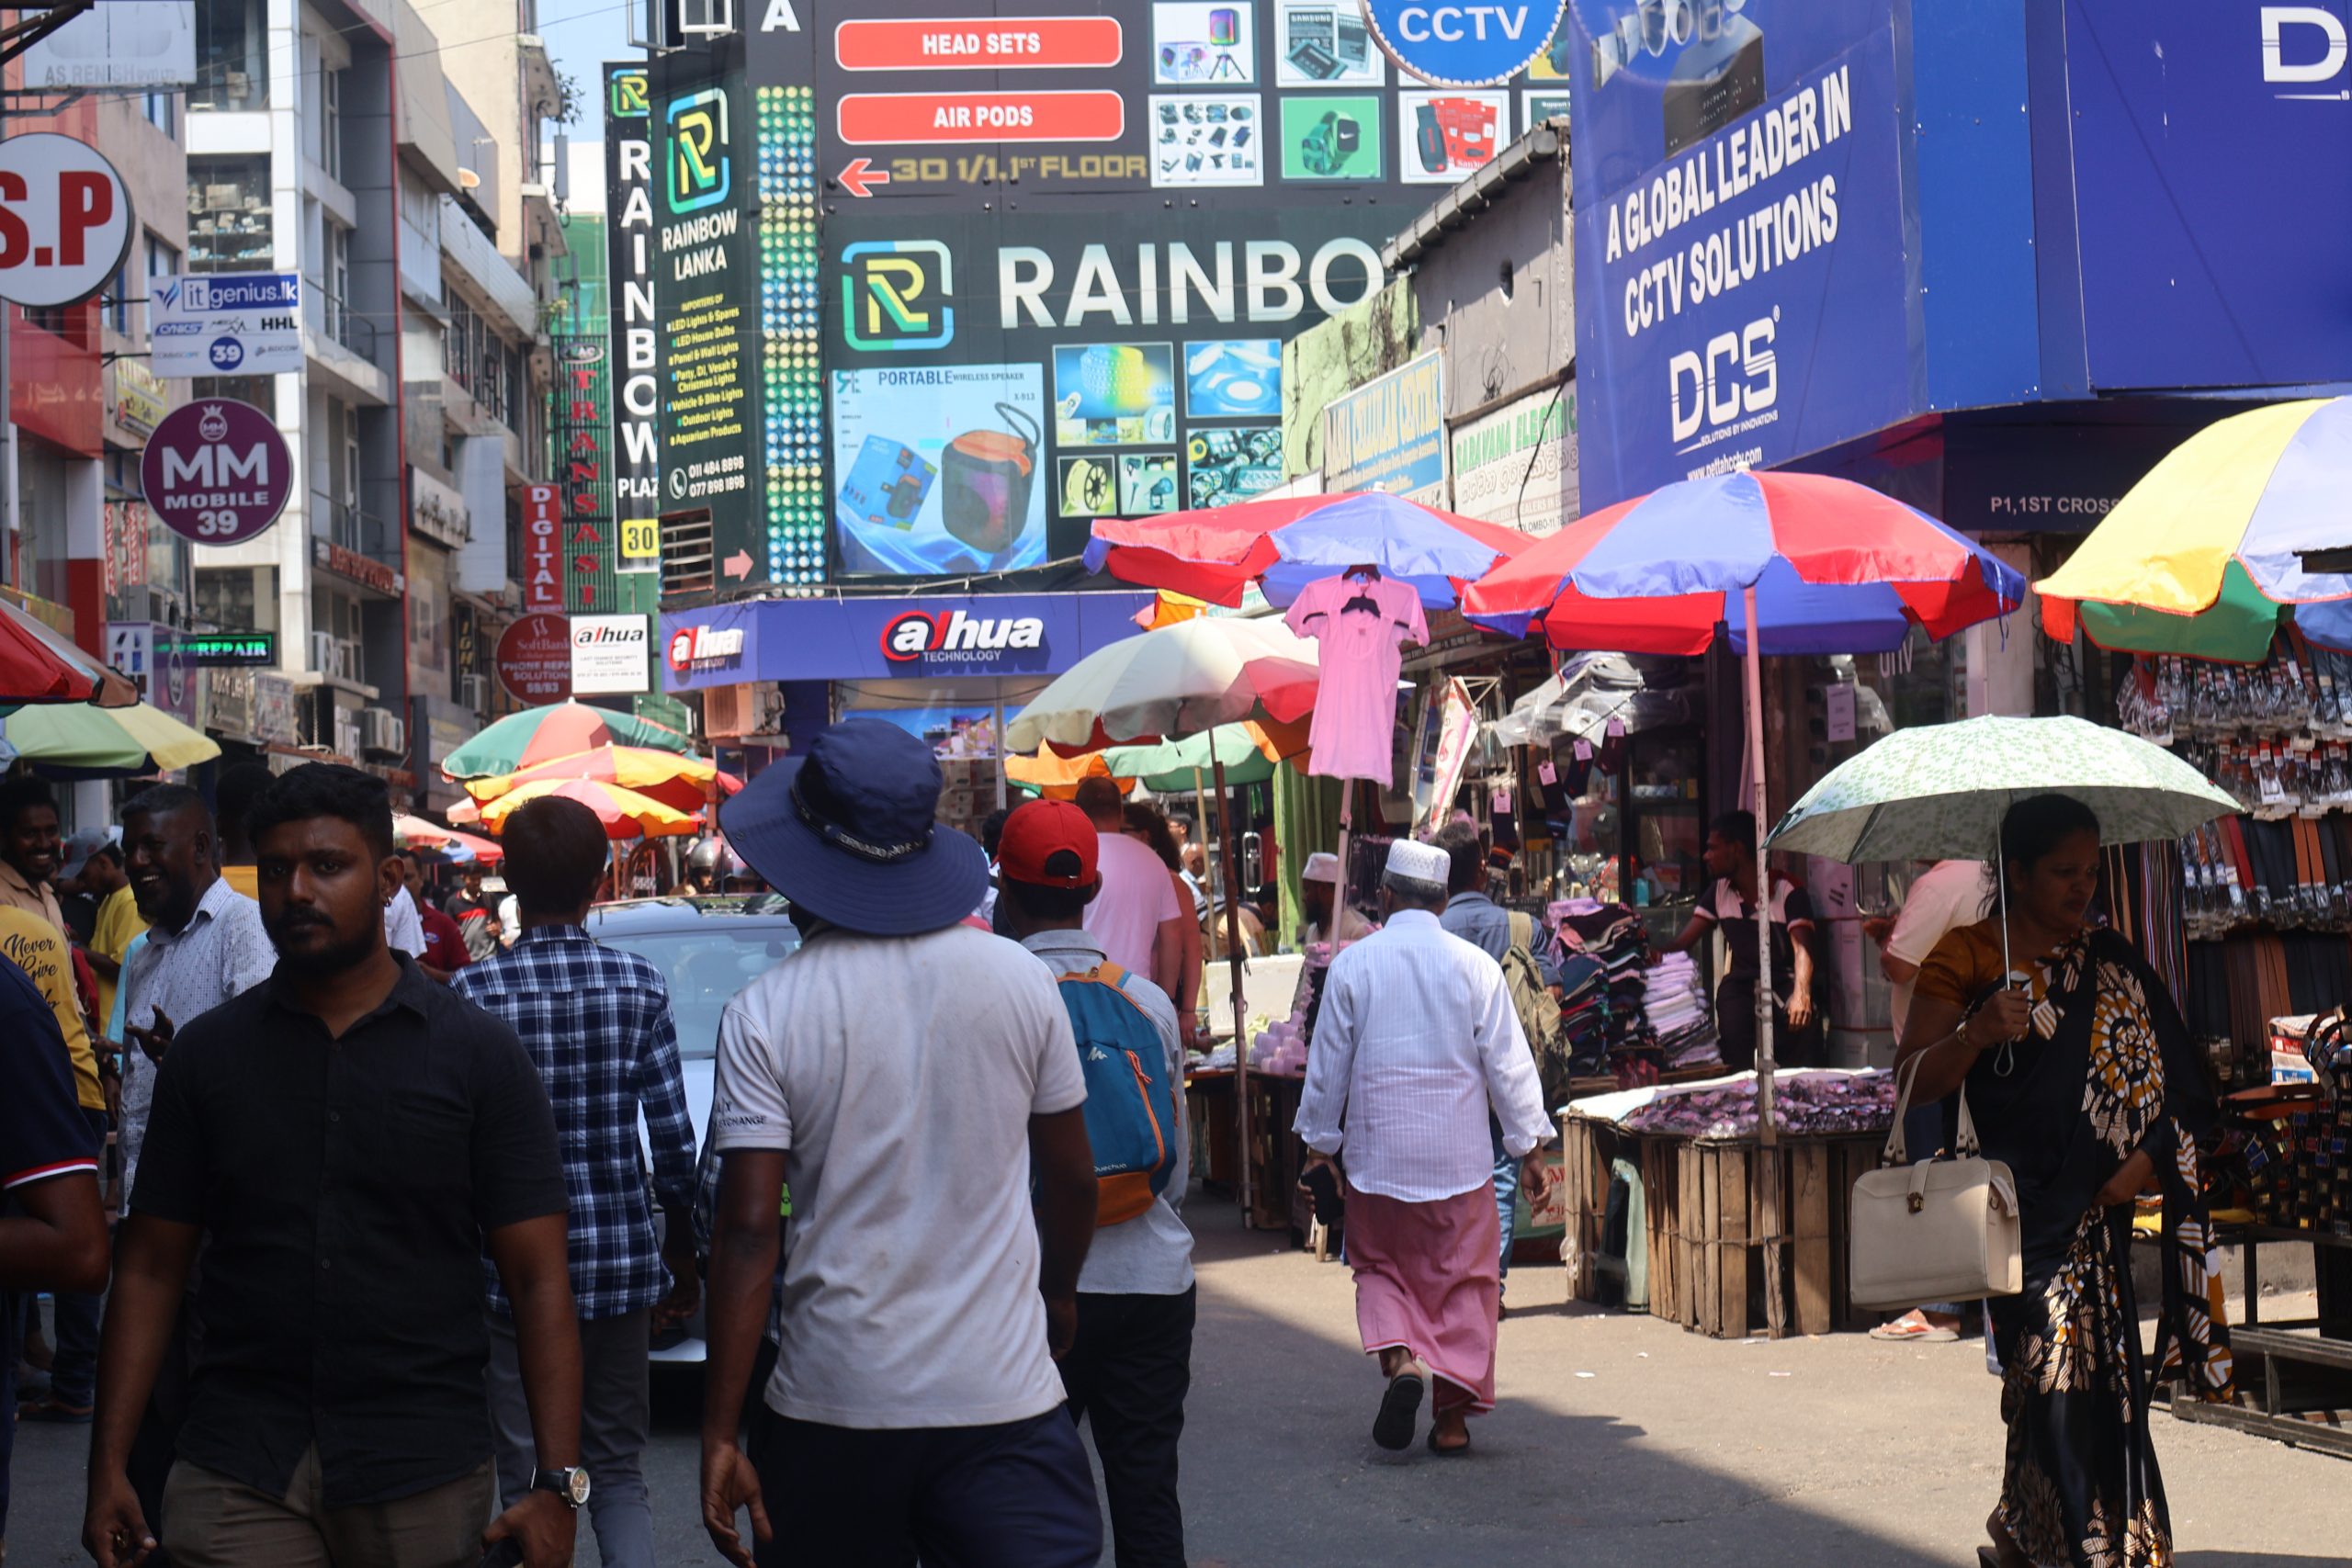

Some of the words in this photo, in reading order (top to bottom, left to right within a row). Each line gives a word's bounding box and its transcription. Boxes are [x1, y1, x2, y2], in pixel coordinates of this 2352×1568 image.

[1397, 5, 1529, 42] CCTV
[922, 33, 982, 55] HEAD
[987, 32, 1041, 54] SETS
[2261, 6, 2348, 83] D
[45, 64, 66, 85] AS
[933, 106, 971, 128] AIR
[976, 106, 1035, 127] PODS
[891, 158, 948, 182] 30
[1040, 155, 1148, 178] FLOOR
[1606, 205, 1623, 264] A
[1624, 150, 1716, 253] GLOBAL
[1717, 87, 1823, 209] LEADER
[1824, 65, 1852, 145] IN
[662, 208, 738, 254] RAINBOW
[674, 245, 728, 282] LANKA
[1624, 251, 1685, 338] CCTV
[1689, 174, 1839, 306] SOLUTIONS
[998, 237, 1386, 330] RAINBO
[619, 140, 659, 464] RAINBOW
[681, 296, 714, 312] IMPORTERS
[715, 293, 724, 304] OF
[261, 317, 298, 331] HHL
[671, 318, 686, 332] LED
[686, 314, 707, 329] Lights
[707, 310, 714, 323] &
[715, 307, 740, 322] Spares
[676, 333, 691, 348] LED
[691, 331, 714, 344] House
[715, 324, 736, 339] Bulbs
[212, 344, 242, 363] 39
[673, 351, 694, 366] Panel
[694, 348, 700, 361] &
[700, 344, 717, 359] Wall
[717, 341, 739, 357] Lights
[730, 357, 738, 369] &
[677, 378, 713, 394] Christmas
[713, 372, 737, 387] Lights
[878, 370, 953, 387] PORTABLE
[953, 373, 990, 382] WIRELESS
[991, 372, 1025, 381] SPEAKER
[1669, 316, 1778, 443] DCS
[672, 396, 697, 412] Vehicle
[697, 394, 705, 407] &
[705, 391, 720, 406] Bike
[720, 388, 744, 402] Lights
[682, 412, 711, 426] Outdoor
[711, 407, 734, 422] Lights
[1701, 424, 1732, 447] SOLUTIONS
[1732, 422, 1741, 435] BY
[1741, 409, 1779, 433] INNOVATIONS
[675, 430, 709, 446] Aquarium
[710, 423, 742, 438] Products
[1456, 419, 1511, 480] SARAVANA
[162, 442, 269, 490] MM
[688, 463, 703, 479] 011
[703, 459, 720, 476] 484
[688, 481, 707, 498] 077
[707, 478, 725, 495] 898
[164, 491, 269, 510] MOBILE
[197, 509, 239, 536] 39
[531, 486, 554, 602] DIGITAL
[502, 661, 542, 671] PHONE
[922, 649, 1002, 663] TECHNOLOGY
[4, 933, 57, 959] Never
